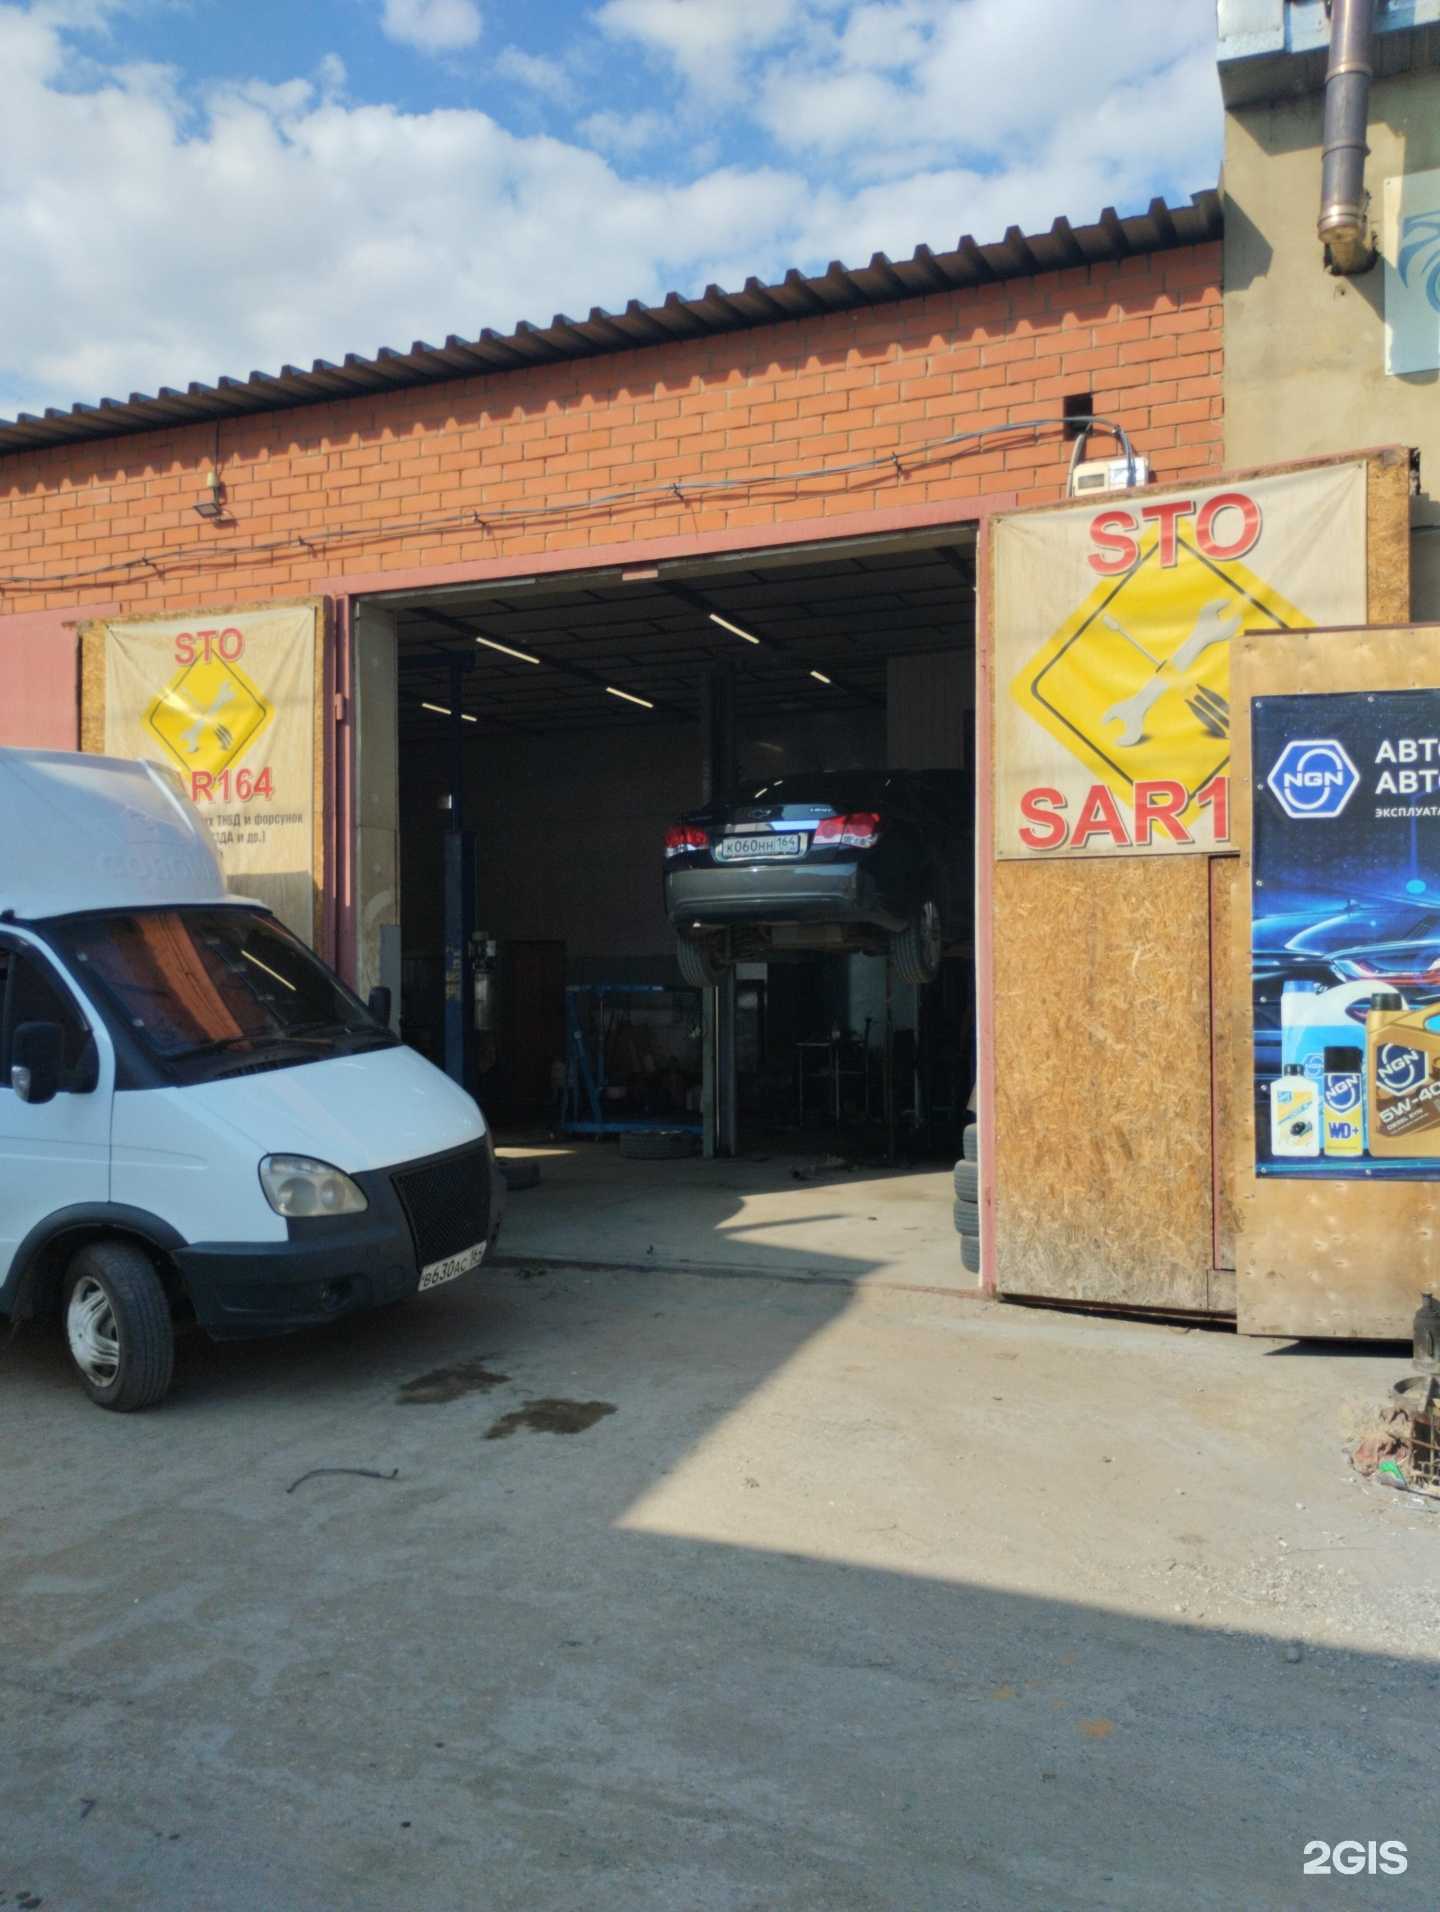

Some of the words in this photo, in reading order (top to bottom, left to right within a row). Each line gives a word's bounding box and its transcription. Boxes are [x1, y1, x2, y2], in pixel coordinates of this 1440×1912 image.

[1087, 493, 1262, 576] STO
[175, 628, 244, 666] STO
[1375, 739, 1440, 763] АВТ
[177, 767, 273, 801] R164
[1284, 772, 1344, 787] NGN
[1375, 770, 1440, 794] АВТ
[1378, 1048, 1418, 1078] NGN
